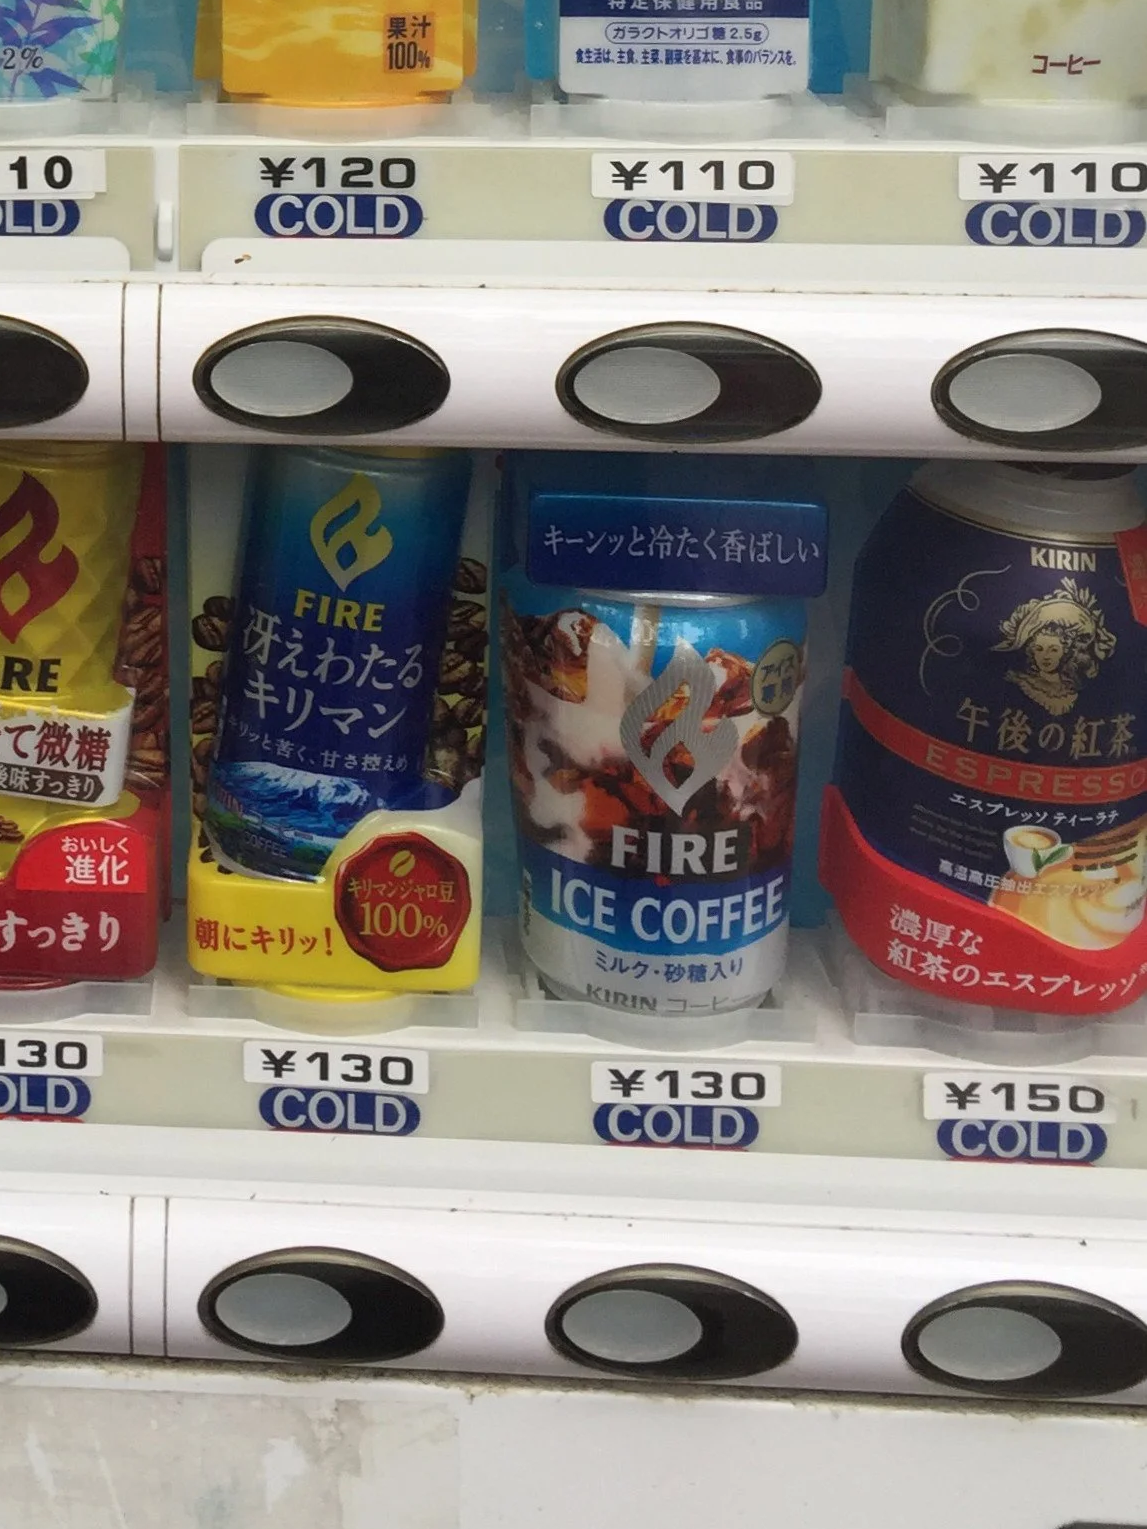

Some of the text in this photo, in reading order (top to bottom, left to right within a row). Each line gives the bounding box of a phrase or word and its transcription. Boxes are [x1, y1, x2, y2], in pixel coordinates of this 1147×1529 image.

[387, 14, 432, 39] 果汁
[386, 41, 431, 71] 100%
[1032, 54, 1102, 76] コーヒー
[259, 157, 416, 189] ¥120
[610, 160, 775, 191] ¥110
[977, 161, 1147, 194] ¥110
[268, 194, 410, 237] COLD
[619, 199, 764, 240] COLD
[981, 203, 1131, 246] COLD
[543, 523, 821, 565] キーンッと冷たく香ばしい
[1030, 546, 1097, 573] KIRIN
[294, 588, 385, 633] FIRE
[241, 604, 424, 690] 冴えわたる
[243, 669, 408, 740] キリマン
[956, 697, 1137, 761] 午後の紅茶
[925, 742, 1147, 798] ESPRESSO
[949, 792, 1048, 826] エスプレッソ
[60, 836, 131, 854] おいしく
[611, 823, 740, 876] FIRE
[65, 854, 130, 885] 進化
[347, 876, 456, 906] キリマンジャロ豆
[551, 867, 617, 936] ICE
[631, 874, 785, 945] COFFEE
[195, 916, 335, 958] 朝にキリッ！
[359, 901, 449, 942] 100%
[888, 903, 984, 956] 濃厚な
[595, 949, 744, 983] ミルク・砂糖入り
[887, 938, 1138, 1002] 紅茶のエスプレッソ
[585, 983, 761, 1013] KIRIN コーヒー
[261, 1048, 415, 1088] ¥130
[608, 1068, 767, 1101] ¥130
[273, 1089, 408, 1134] COLD
[944, 1081, 1106, 1114] ¥150
[608, 1105, 746, 1145] COLD
[952, 1120, 1094, 1160] COLD
